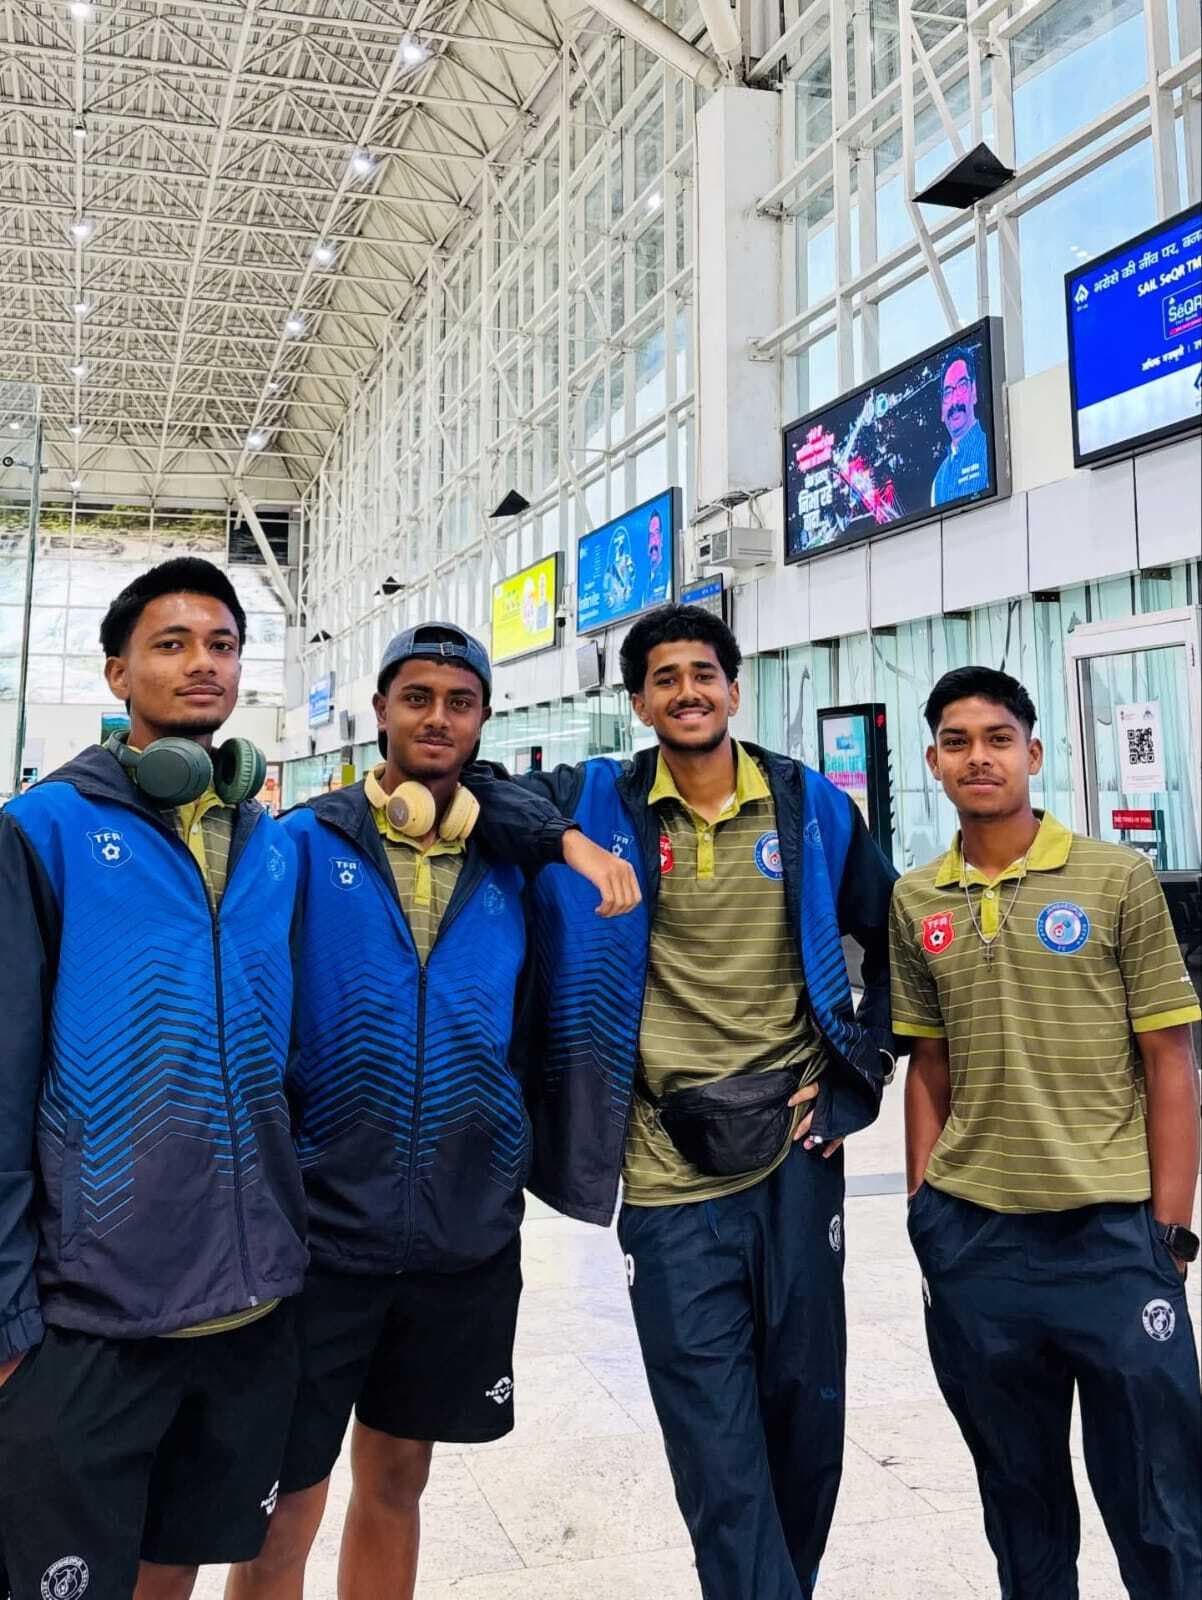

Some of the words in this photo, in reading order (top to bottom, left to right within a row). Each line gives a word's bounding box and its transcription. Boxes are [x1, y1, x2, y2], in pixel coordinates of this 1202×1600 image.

[1121, 260, 1136, 278] की
[1137, 278, 1159, 297] SAIL
[1186, 255, 1202, 273] TM
